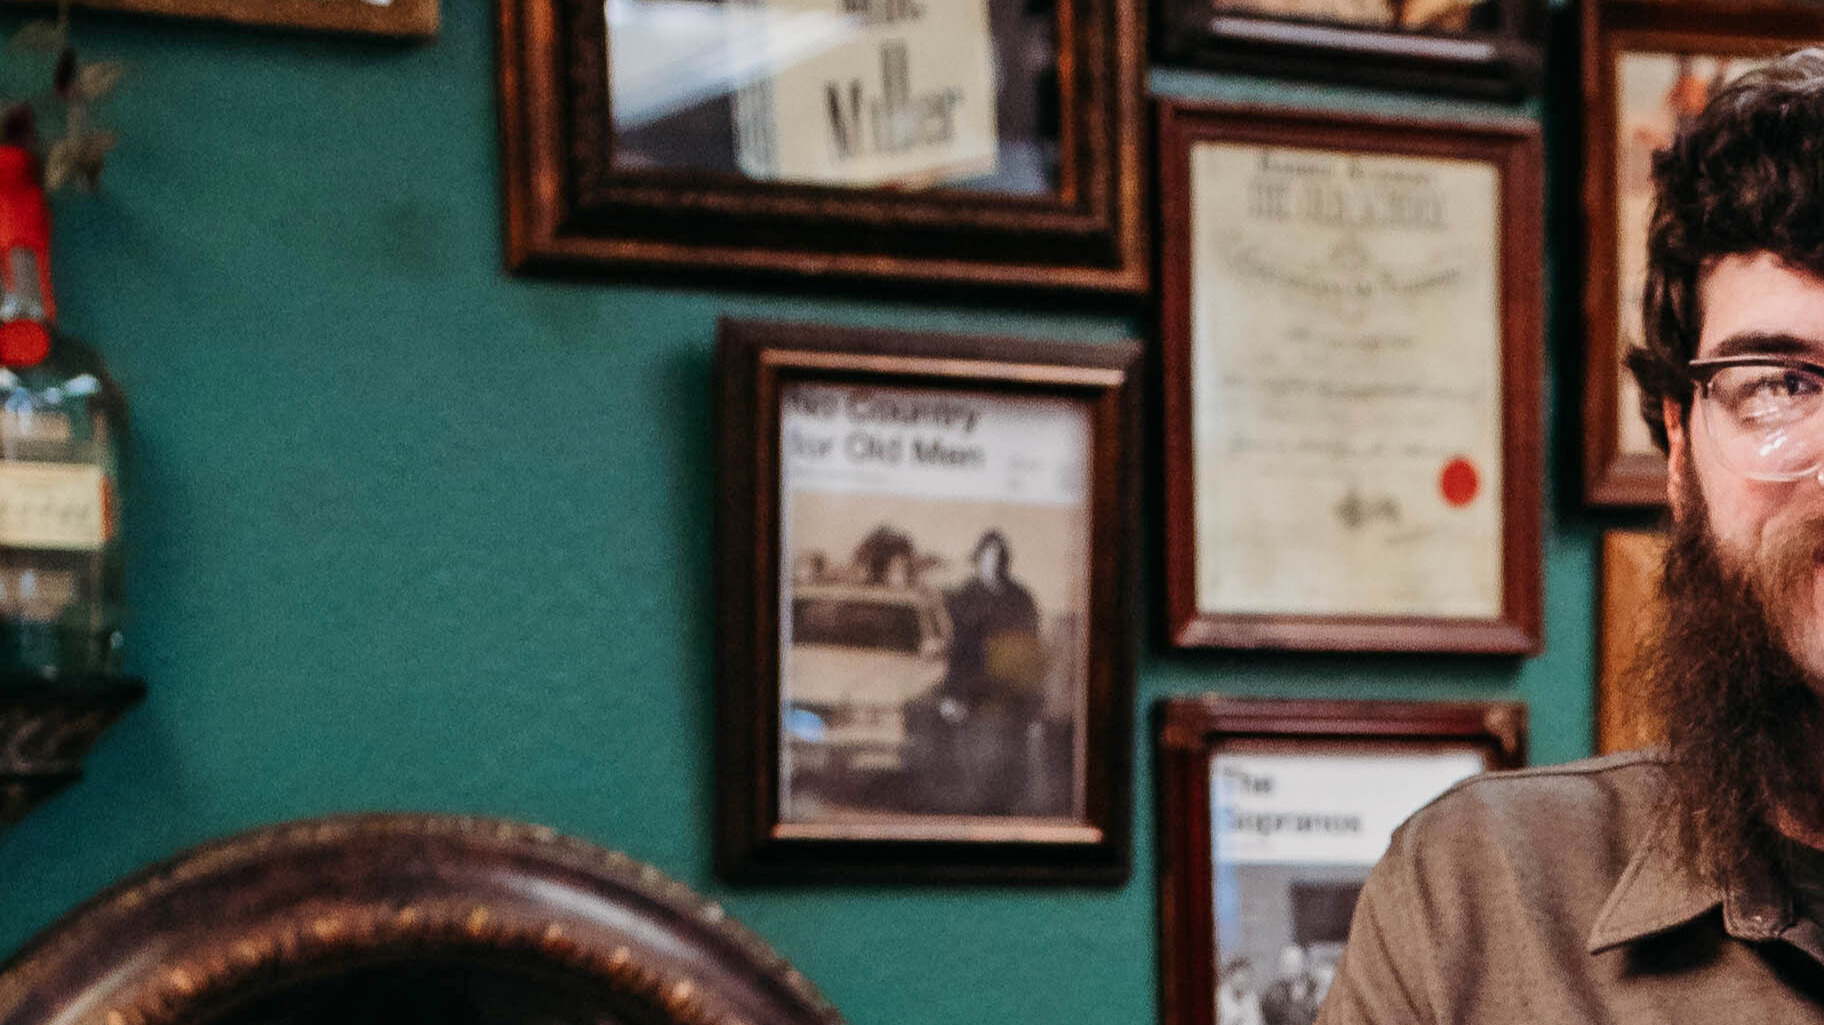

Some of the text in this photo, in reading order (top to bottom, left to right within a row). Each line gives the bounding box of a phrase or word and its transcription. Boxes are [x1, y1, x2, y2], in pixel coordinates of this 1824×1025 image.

[846, 387, 979, 433] Country
[843, 430, 903, 465] Old
[911, 438, 988, 467] Men
